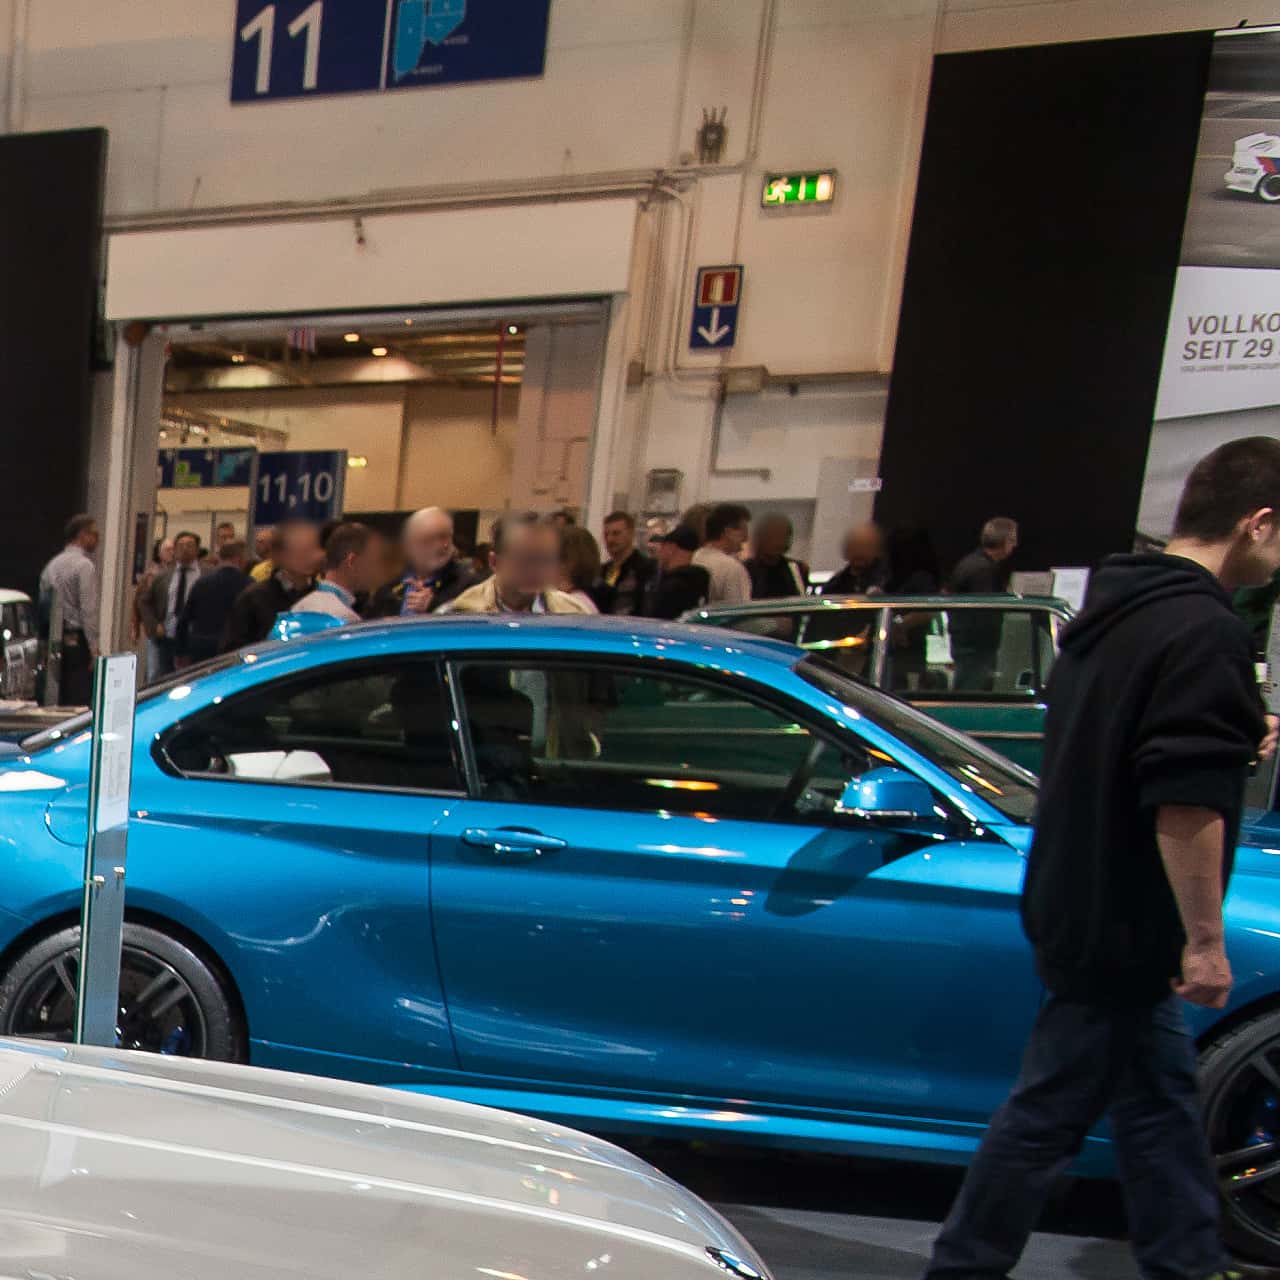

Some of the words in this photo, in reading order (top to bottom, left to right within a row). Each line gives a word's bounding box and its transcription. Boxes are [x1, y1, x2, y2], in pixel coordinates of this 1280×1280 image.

[240, 0, 323, 94] 11
[1182, 339, 1240, 361] SEIT
[1243, 337, 1273, 359] 29
[258, 471, 333, 508] 11,10
